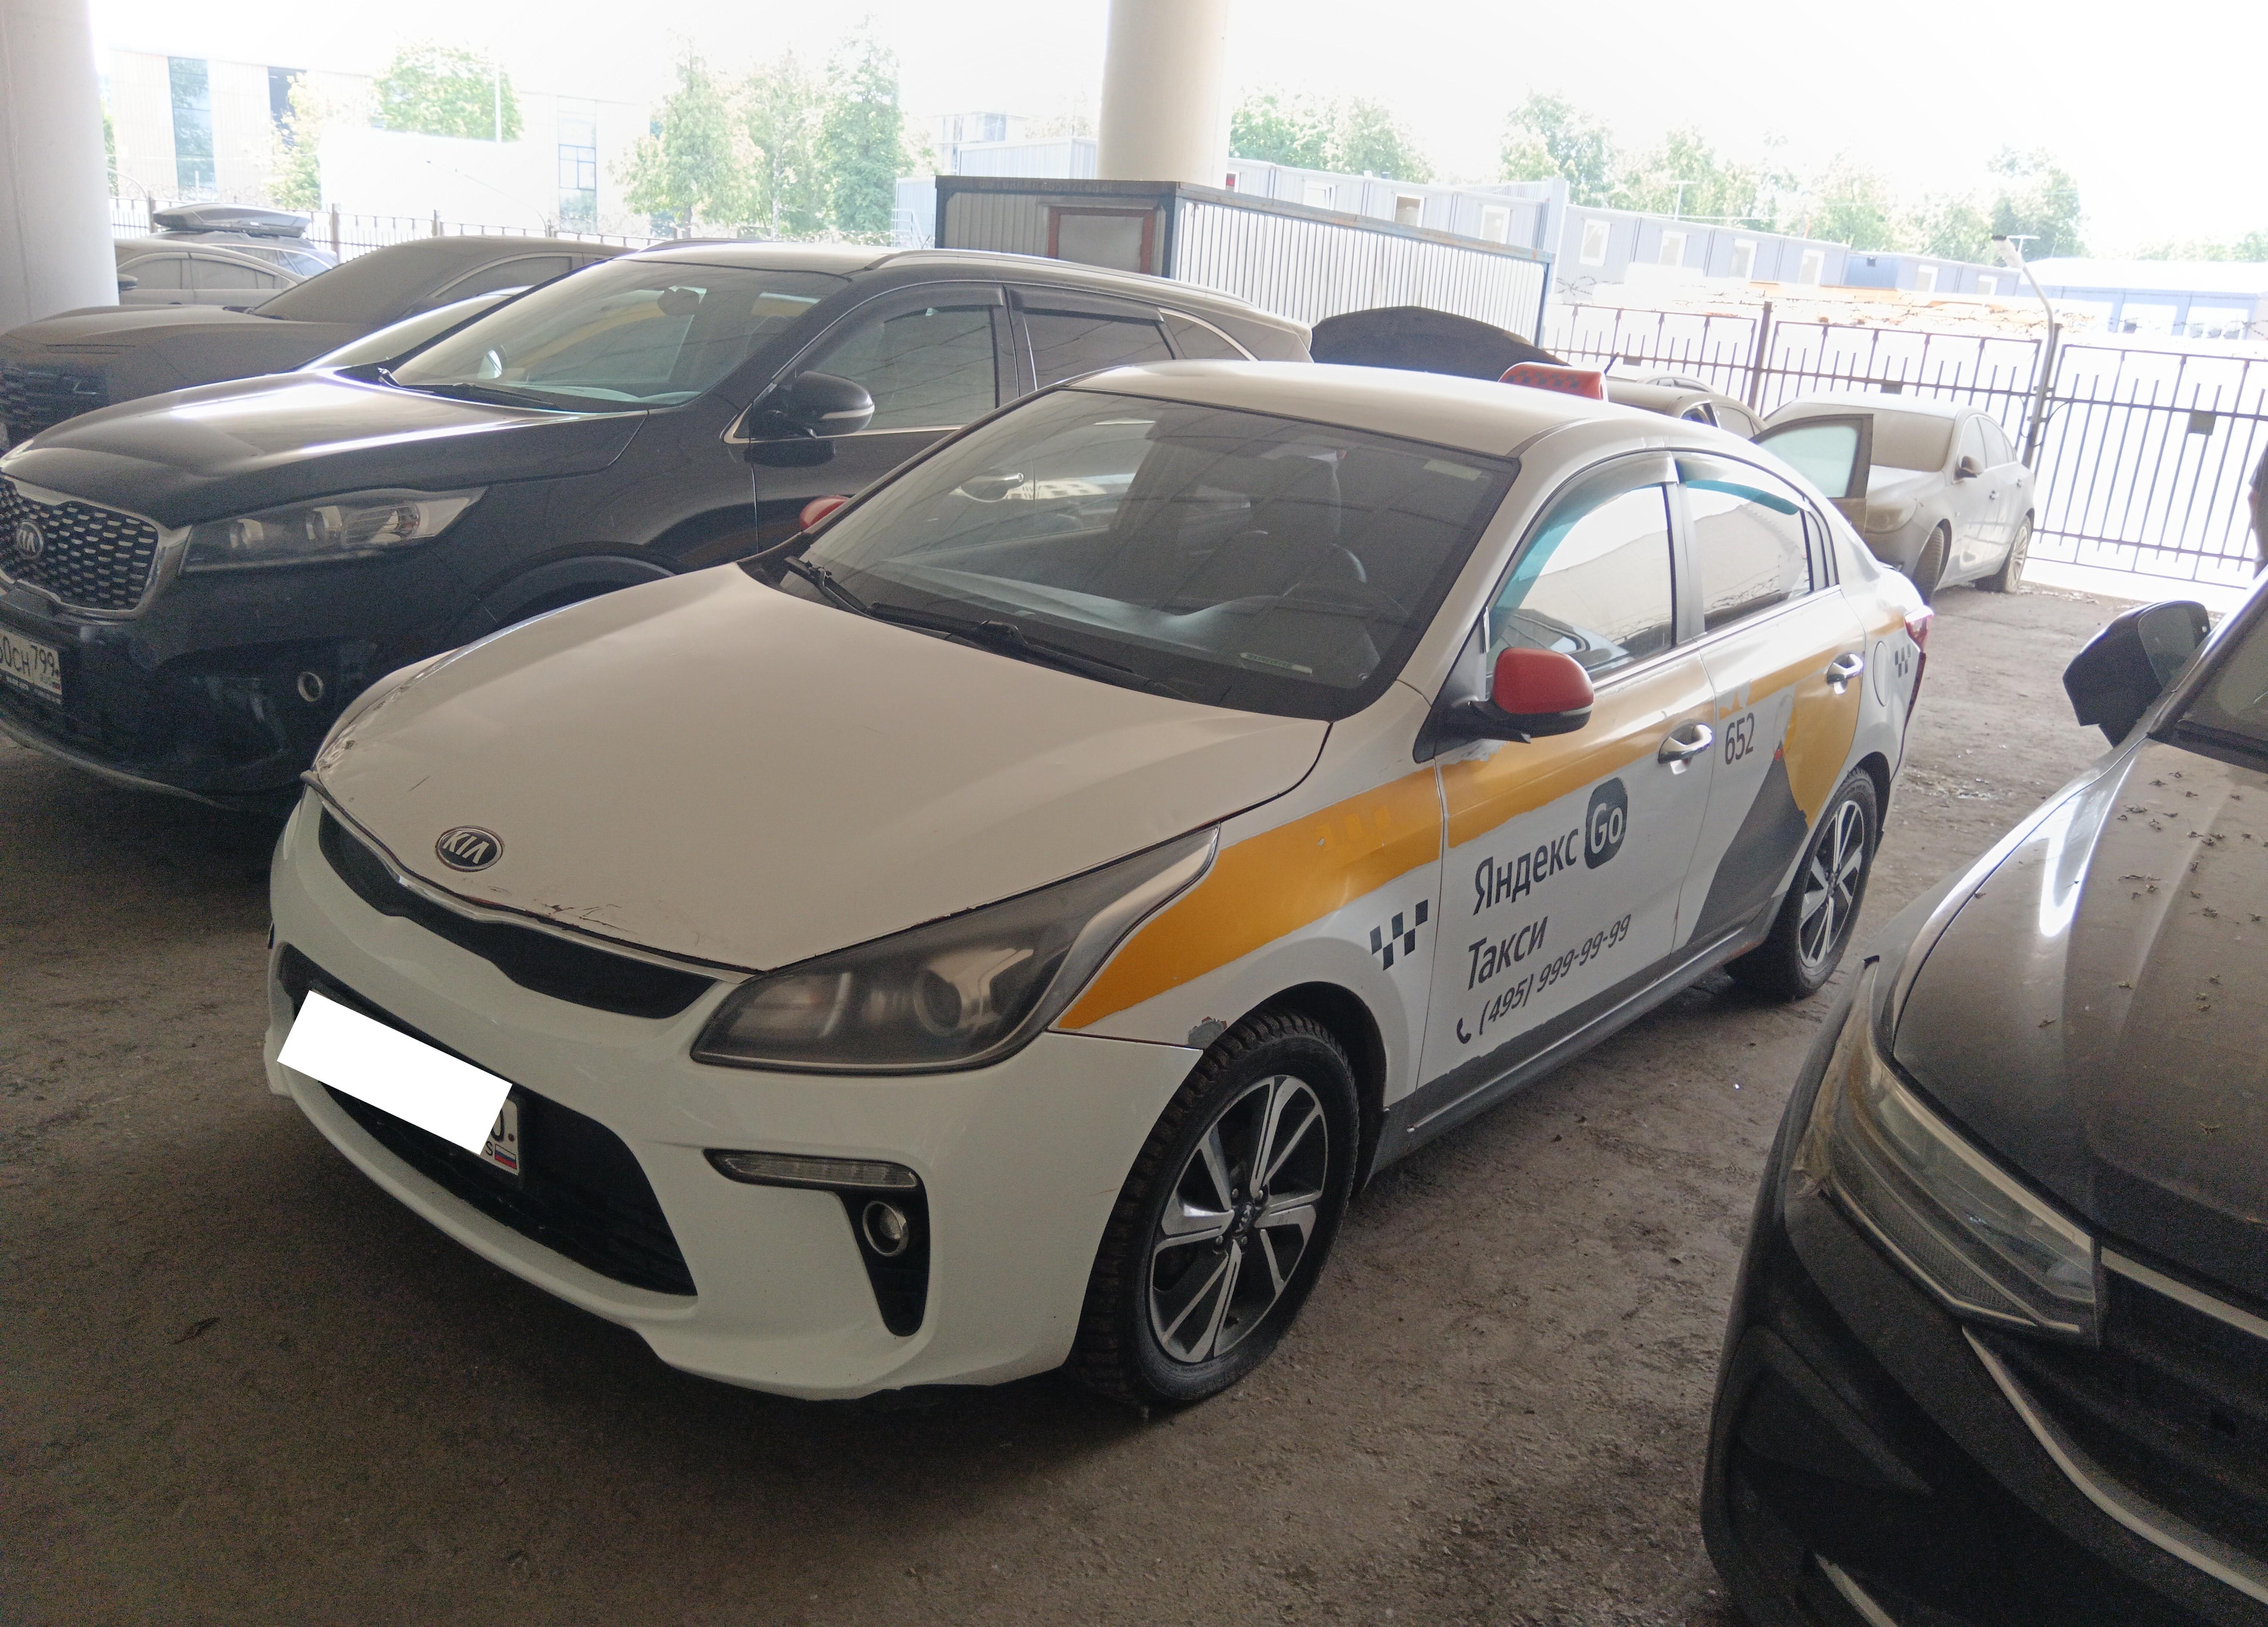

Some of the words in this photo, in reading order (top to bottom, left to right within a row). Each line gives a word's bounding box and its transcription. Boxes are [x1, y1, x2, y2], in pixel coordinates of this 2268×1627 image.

[1725, 712, 1754, 765] 652
[442, 830, 489, 864] KIA
[1473, 828, 1578, 916] Яндекс
[1591, 803, 1623, 854] Go
[1468, 916, 1548, 991] Такси
[1479, 974, 1534, 1036] (495)
[1537, 914, 1631, 992] 999-99-99
